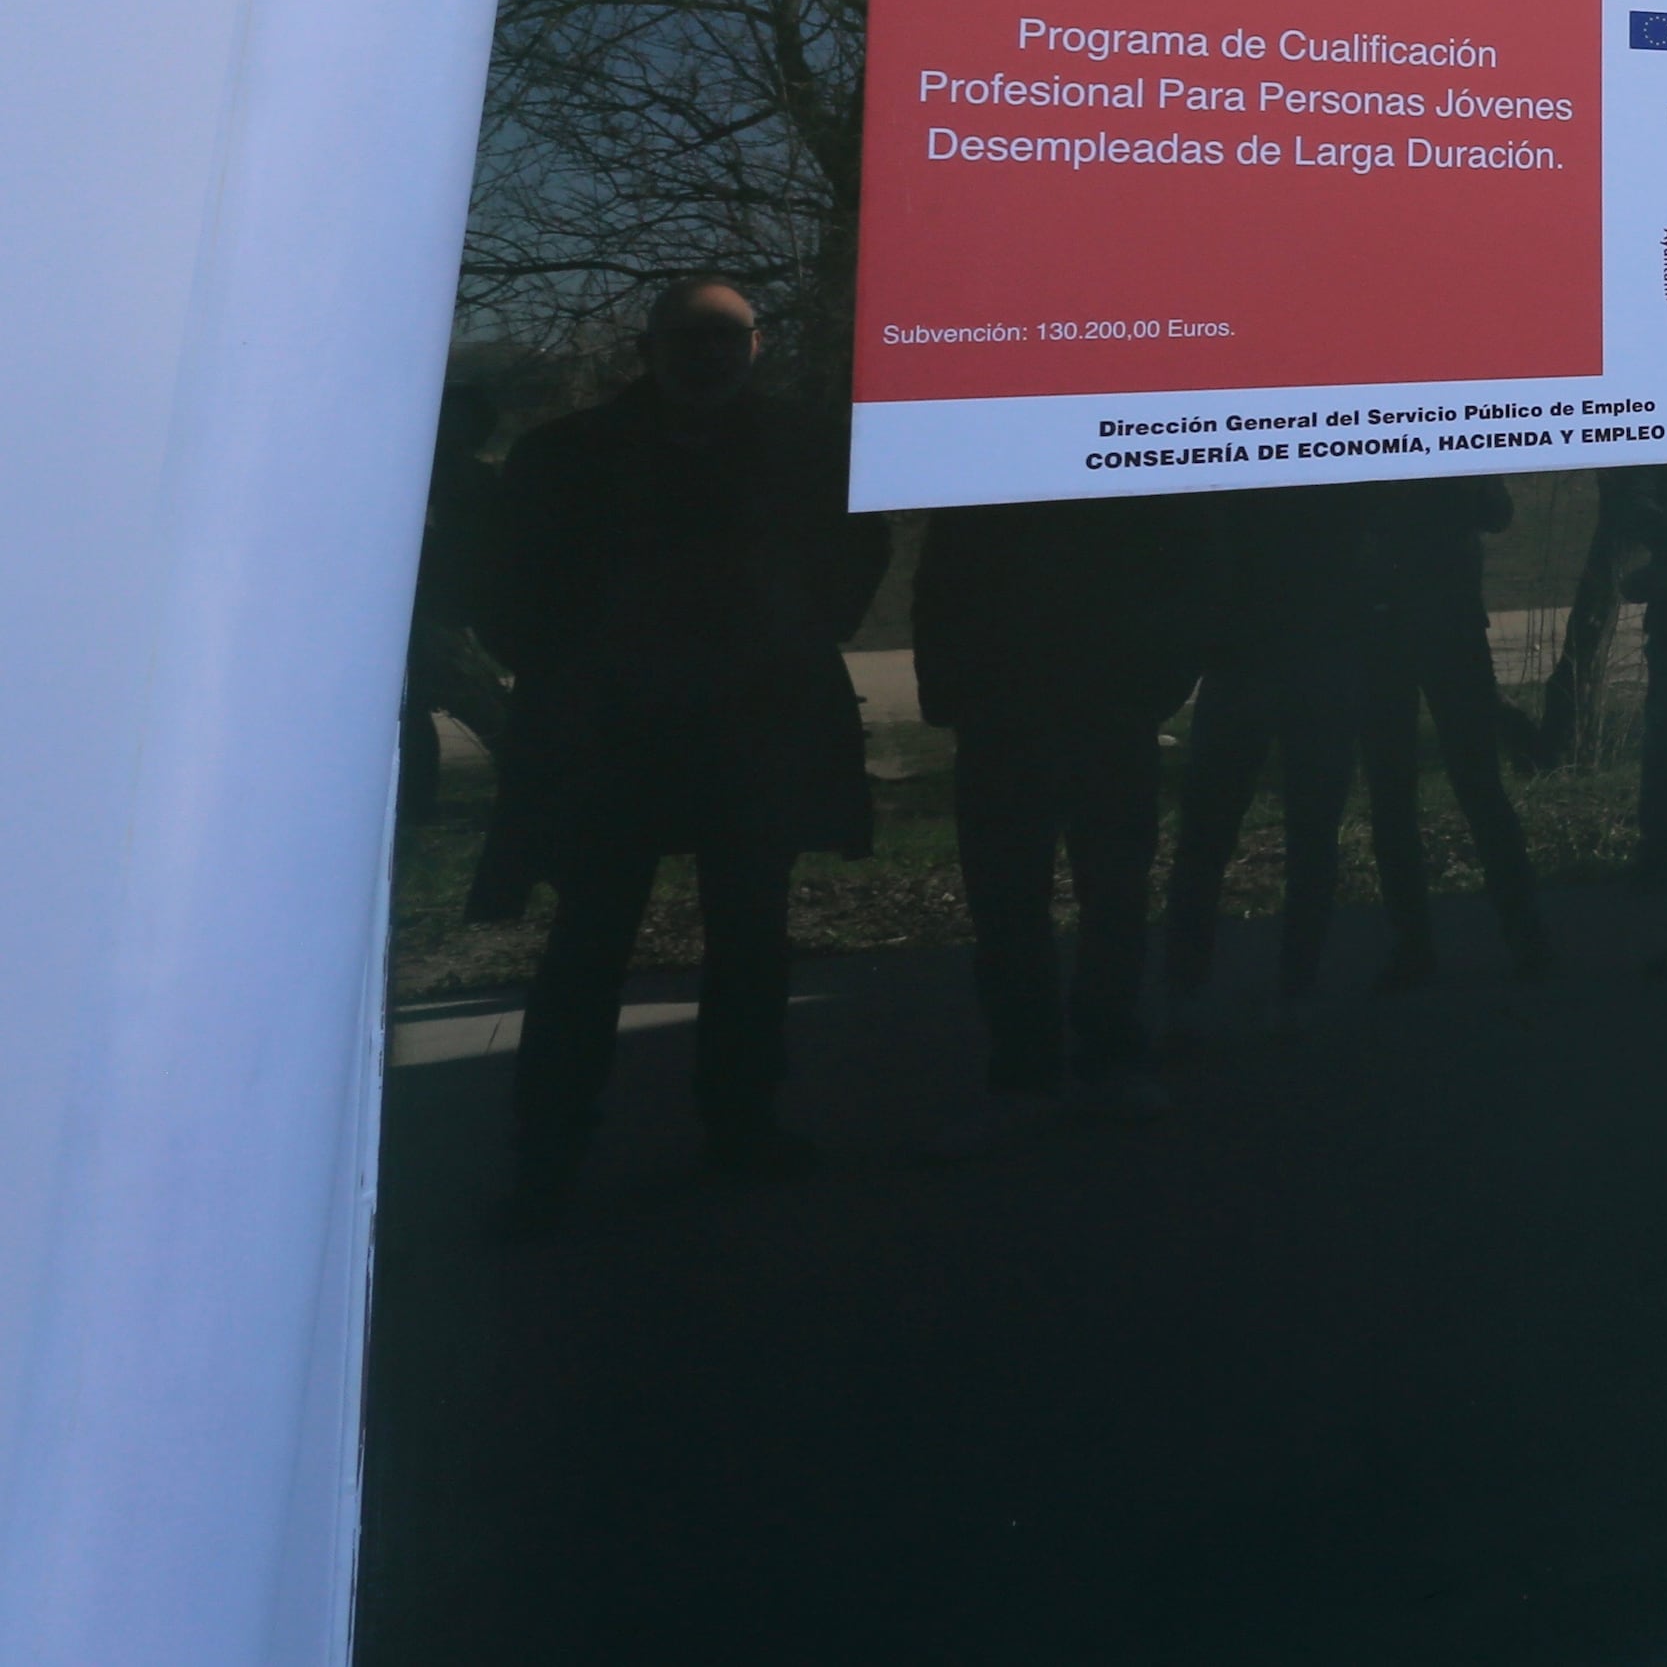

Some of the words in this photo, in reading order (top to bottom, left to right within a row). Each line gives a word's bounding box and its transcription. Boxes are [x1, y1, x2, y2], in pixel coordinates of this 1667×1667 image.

[1018, 16, 1209, 61] Programa
[1220, 28, 1266, 59] de
[1278, 29, 1498, 68] Cualificación
[919, 69, 1144, 109] Profesional
[1159, 77, 1246, 112] Para
[1259, 80, 1426, 117] Personas
[1436, 88, 1573, 121] Jóvenes
[926, 126, 1225, 170] Desempleadas
[1236, 134, 1282, 166] de
[1294, 135, 1396, 174] Larga
[1407, 137, 1564, 170] Duración.
[883, 322, 1029, 345] Subvención:
[1036, 319, 1161, 341] 130.200,00
[1168, 319, 1236, 338] Euros.
[1098, 416, 1218, 438] Dirección
[1225, 411, 1318, 432] General
[1325, 407, 1360, 427] del
[1367, 404, 1458, 426] Servicio
[1463, 400, 1543, 421] Público
[1549, 399, 1576, 417] de
[1581, 397, 1656, 418] Empleo
[1085, 442, 1250, 470] CONSEJERÍA
[1257, 441, 1290, 461] DE
[1298, 435, 1432, 459] ECONOMÍA,
[1438, 430, 1553, 452] HACIENDA
[1561, 429, 1575, 444] Y
[1581, 424, 1666, 444] EMPLEO
